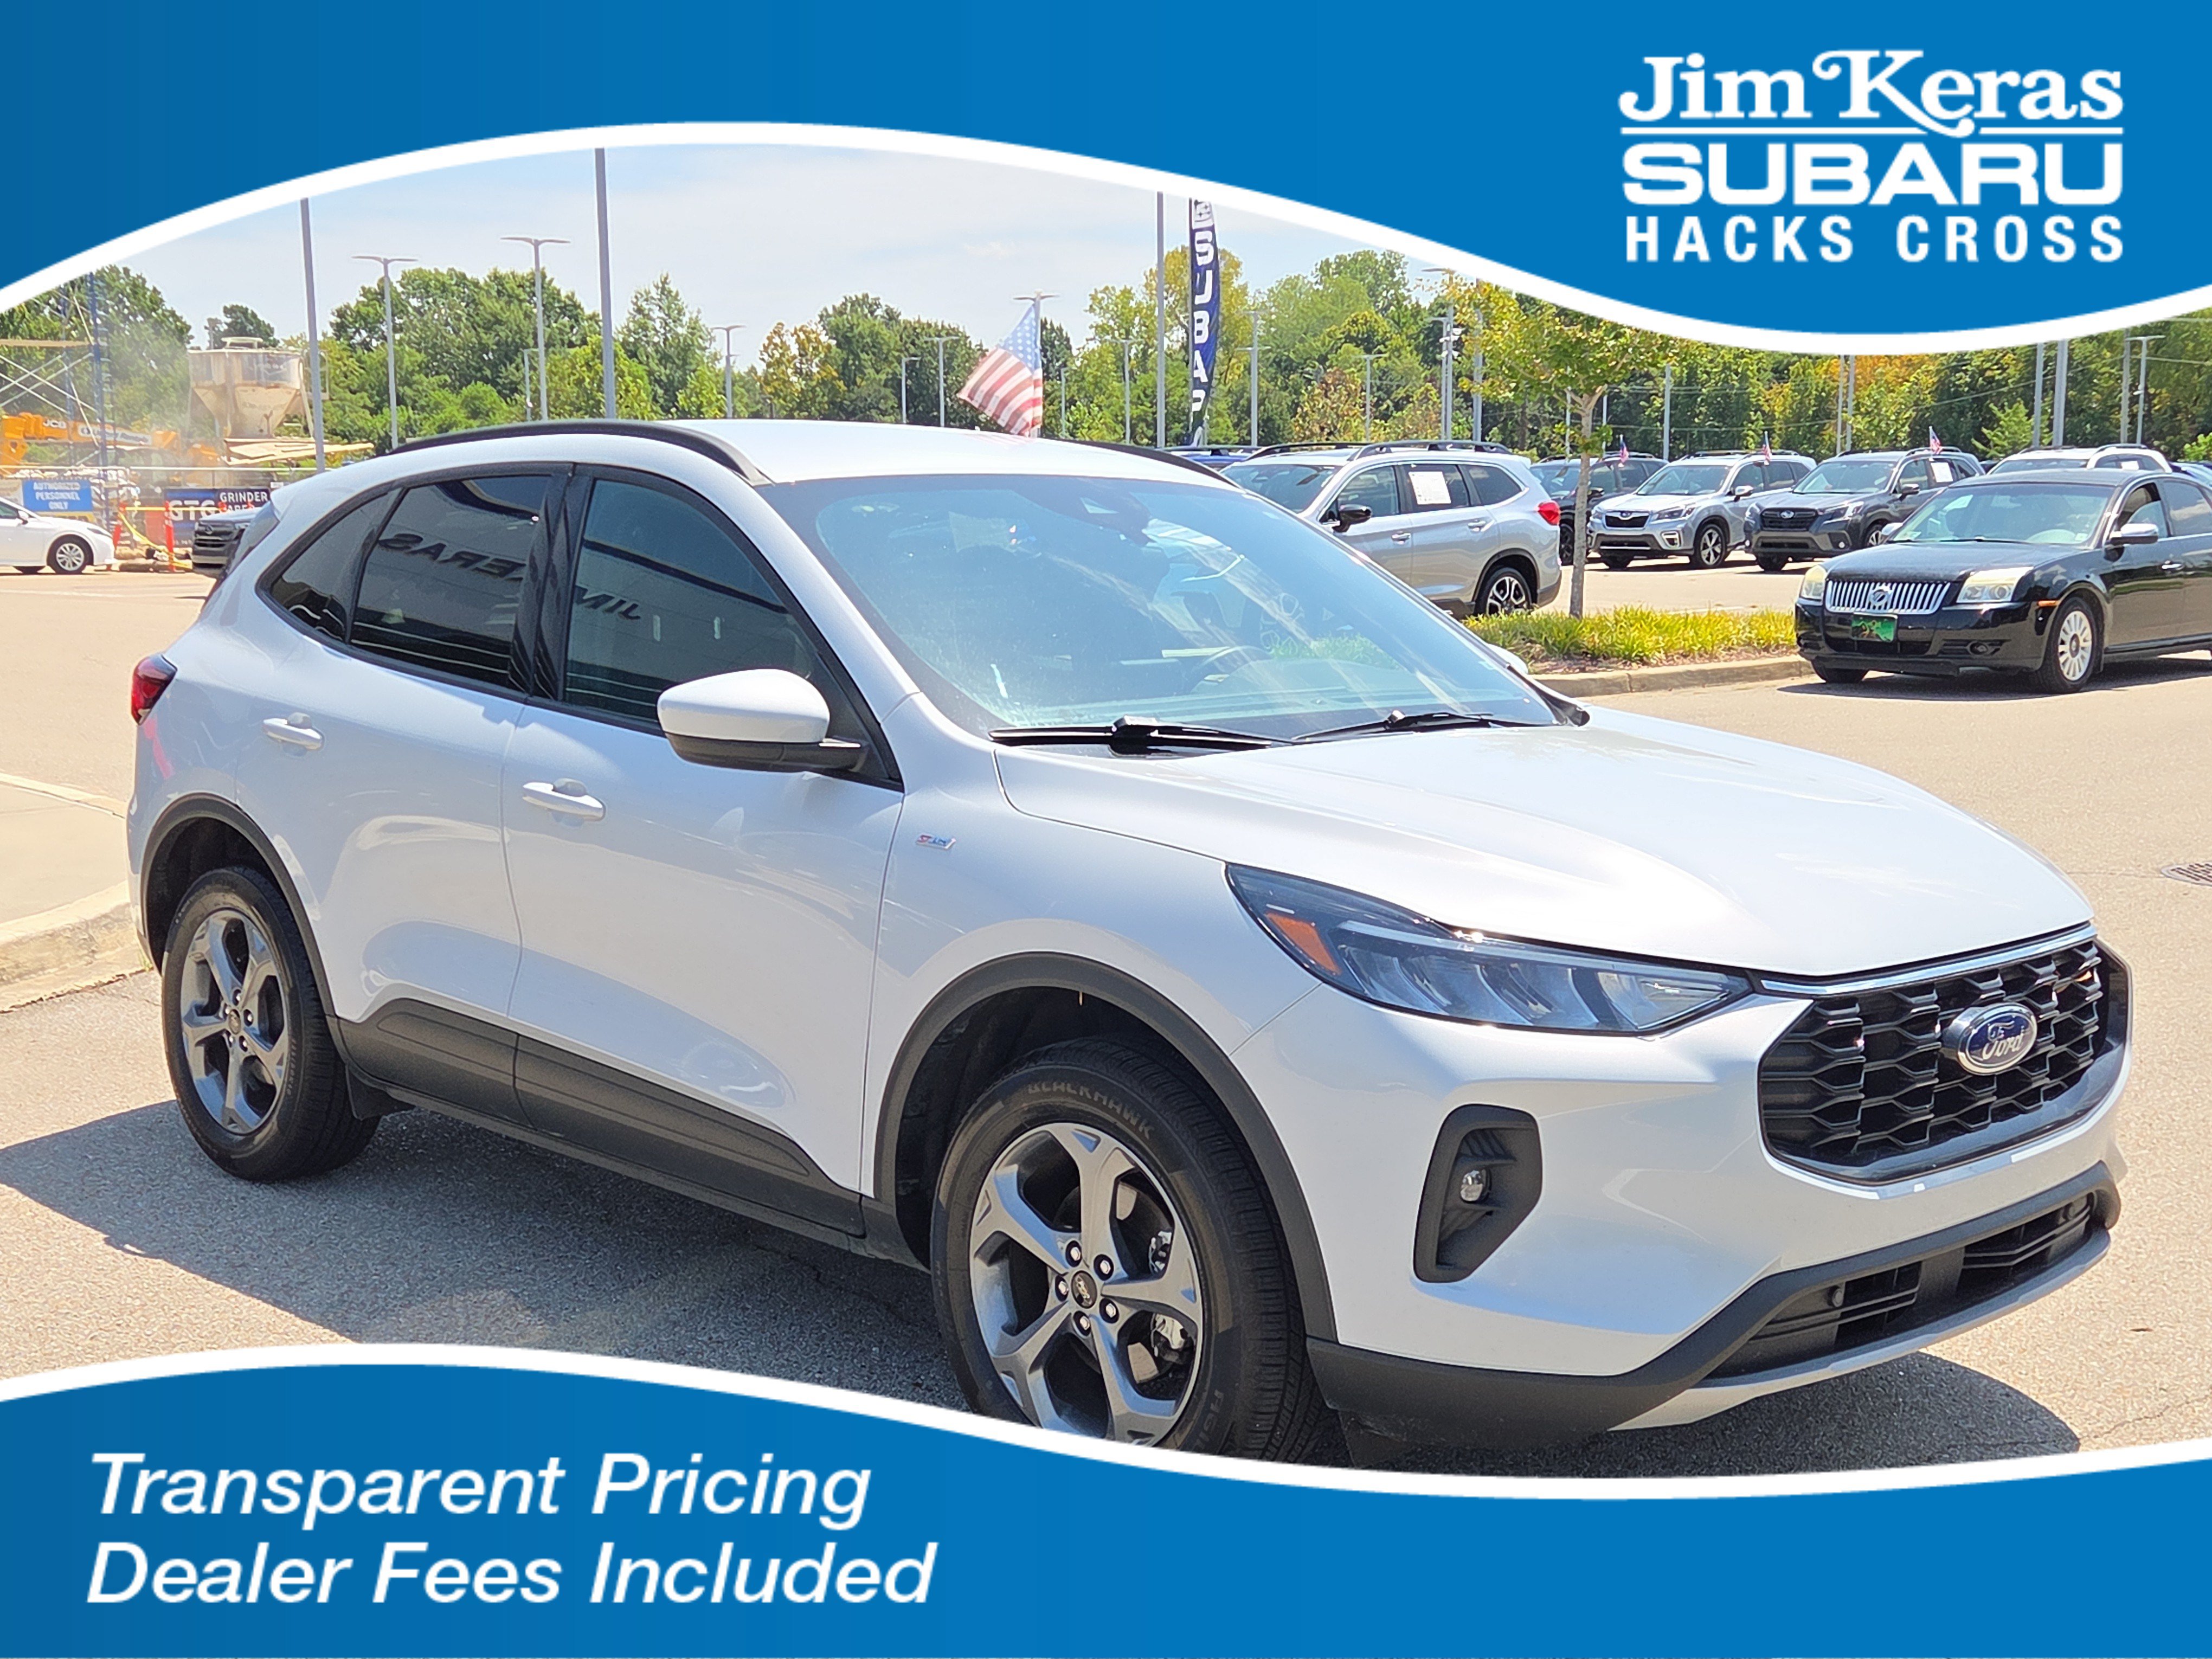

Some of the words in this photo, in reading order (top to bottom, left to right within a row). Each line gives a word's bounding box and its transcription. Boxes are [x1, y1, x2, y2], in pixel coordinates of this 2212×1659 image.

[43, 419, 66, 429] JCB
[35, 491, 81, 500] PERSONNEL
[220, 491, 268, 503] GRINDER
[48, 501, 68, 510] ONLY
[1981, 1020, 2026, 1061] Ford
[1027, 1082, 1155, 1141] BLACKHAWK
